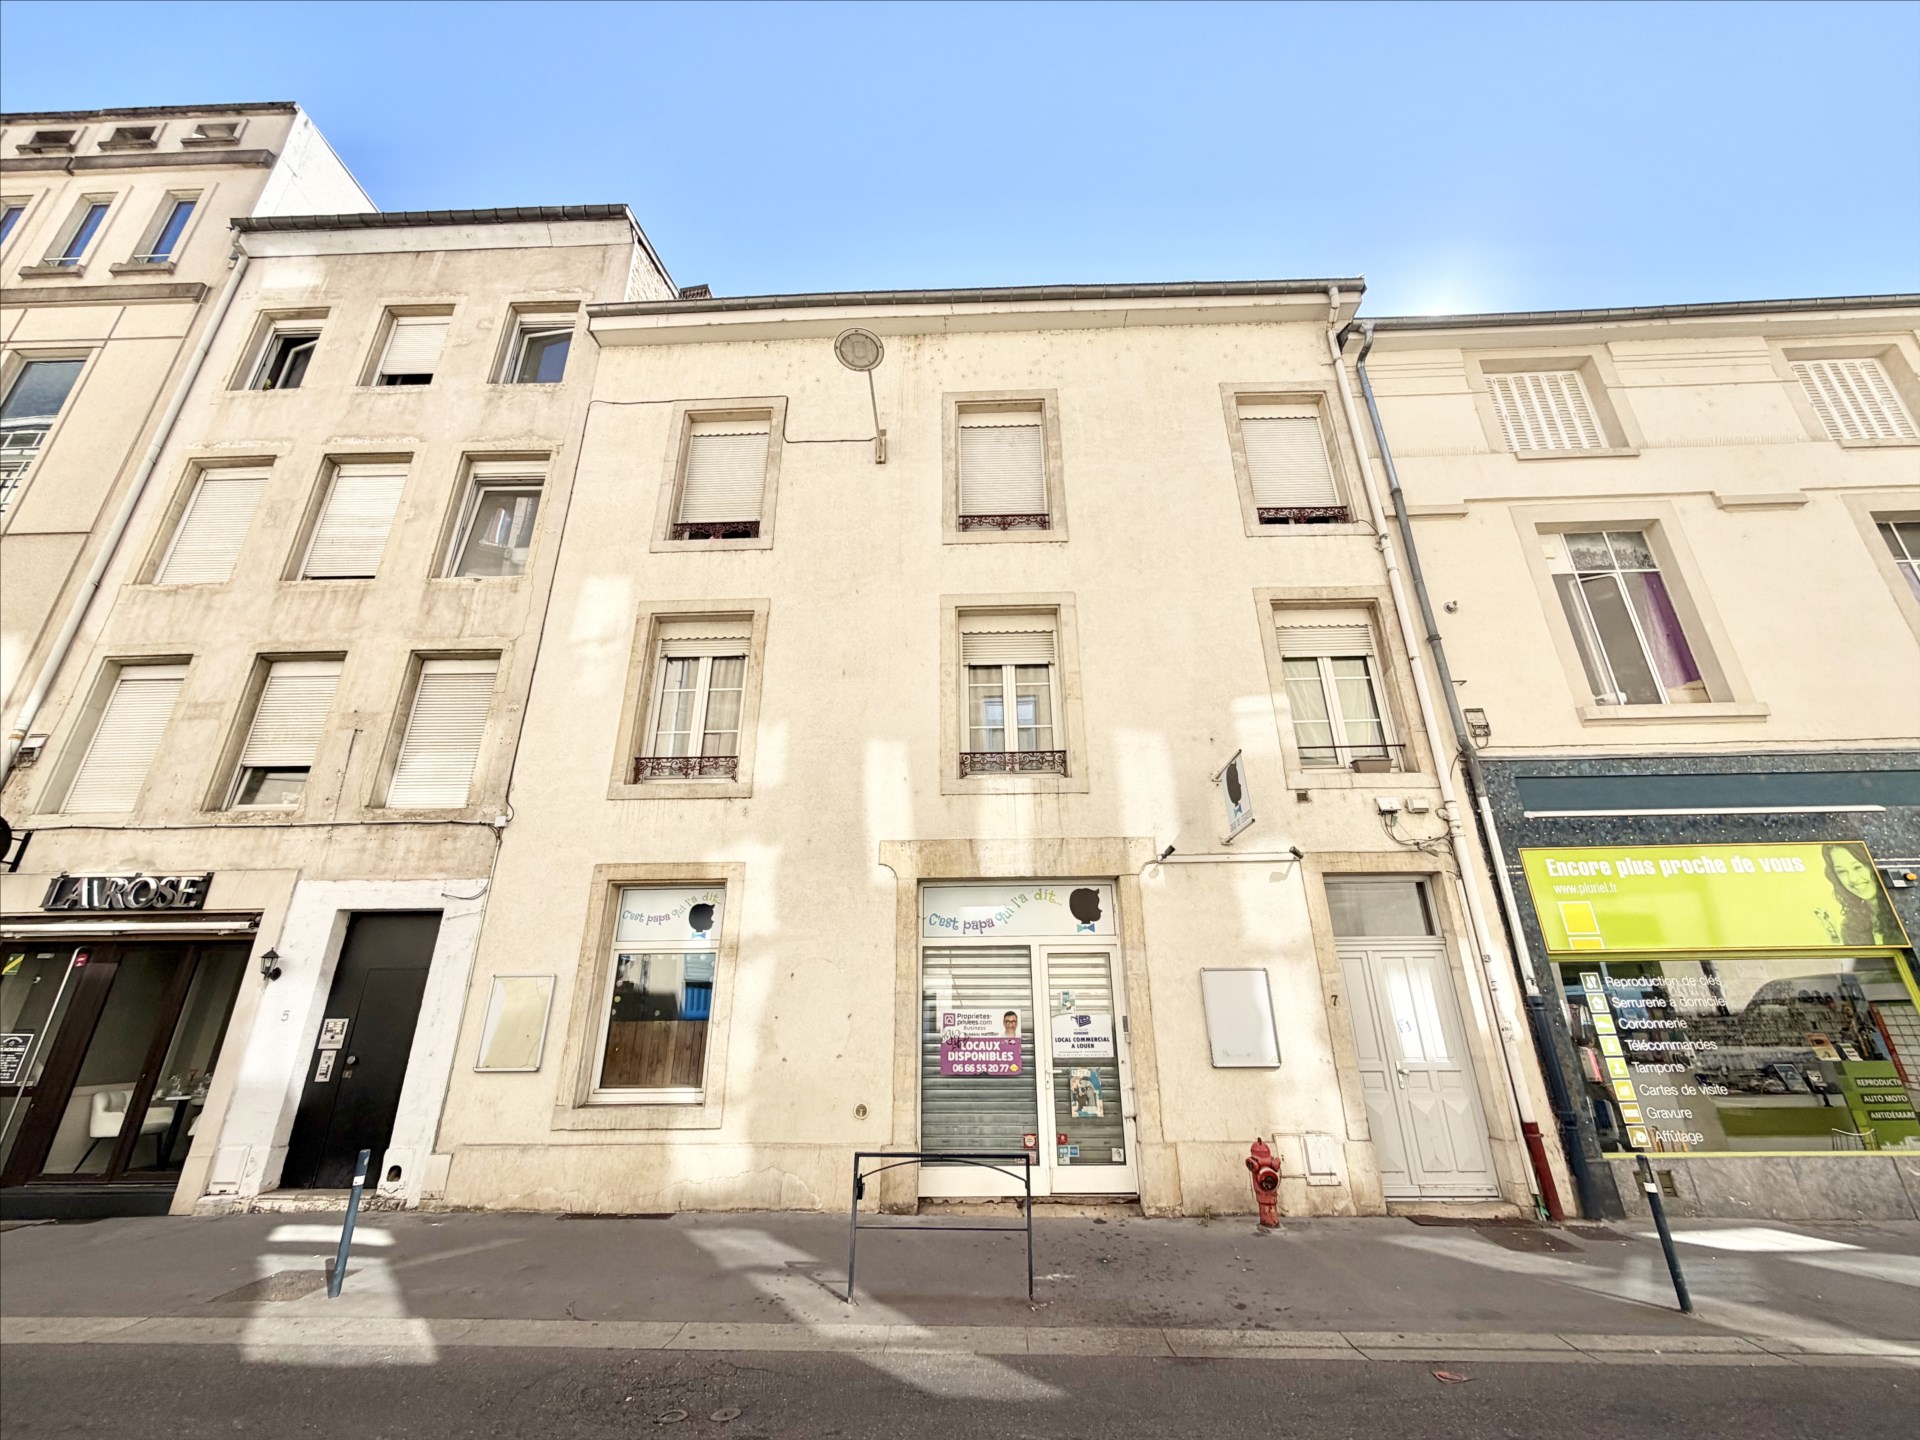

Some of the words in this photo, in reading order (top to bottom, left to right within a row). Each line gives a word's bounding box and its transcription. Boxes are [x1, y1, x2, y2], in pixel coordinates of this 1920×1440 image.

[1545, 858, 1612, 877] Encore
[1615, 857, 1656, 878] plus
[1658, 855, 1728, 878] proche
[1730, 855, 1755, 874] de
[1757, 856, 1806, 873] vous
[98, 876, 203, 909] ROSE
[1553, 881, 1617, 896] www.pluriel.fr
[622, 909, 645, 923] C'est
[646, 913, 671, 926] papa
[671, 903, 687, 918] qui
[685, 895, 698, 907] l'a
[928, 912, 959, 931] C'est
[962, 917, 996, 935] papa
[994, 904, 1015, 925] qui
[1011, 893, 1029, 909] l'a
[1604, 975, 1680, 990] Reproduction
[1681, 975, 1697, 986] de
[1699, 974, 1723, 986] clés
[1330, 994, 1338, 1006] 7
[1611, 996, 1667, 1009] Serrurerie
[1669, 996, 1677, 1008] à
[1680, 995, 1726, 1008] domicile
[281, 1009, 290, 1022] 5
[1618, 1017, 1688, 1030] Cordonnerie
[961, 1041, 1001, 1051] LOCAUX
[1624, 1039, 1719, 1052] Télécommandes
[947, 1051, 1014, 1061] DISPONIBLES
[952, 1063, 963, 1072] 06
[964, 1063, 975, 1073] 66
[976, 1063, 987, 1073] 55
[988, 1063, 999, 1073] 20
[999, 1063, 1010, 1073] 77
[1631, 1061, 1686, 1076] Tampons
[1639, 1083, 1679, 1096] Cartes
[1681, 1083, 1697, 1096] de
[1698, 1083, 1729, 1096] visite
[1863, 1094, 1884, 1104] AUTO
[1884, 1094, 1908, 1103] MOTO
[1646, 1106, 1693, 1120] Gravure
[1655, 1130, 1704, 1145] Affûtage
